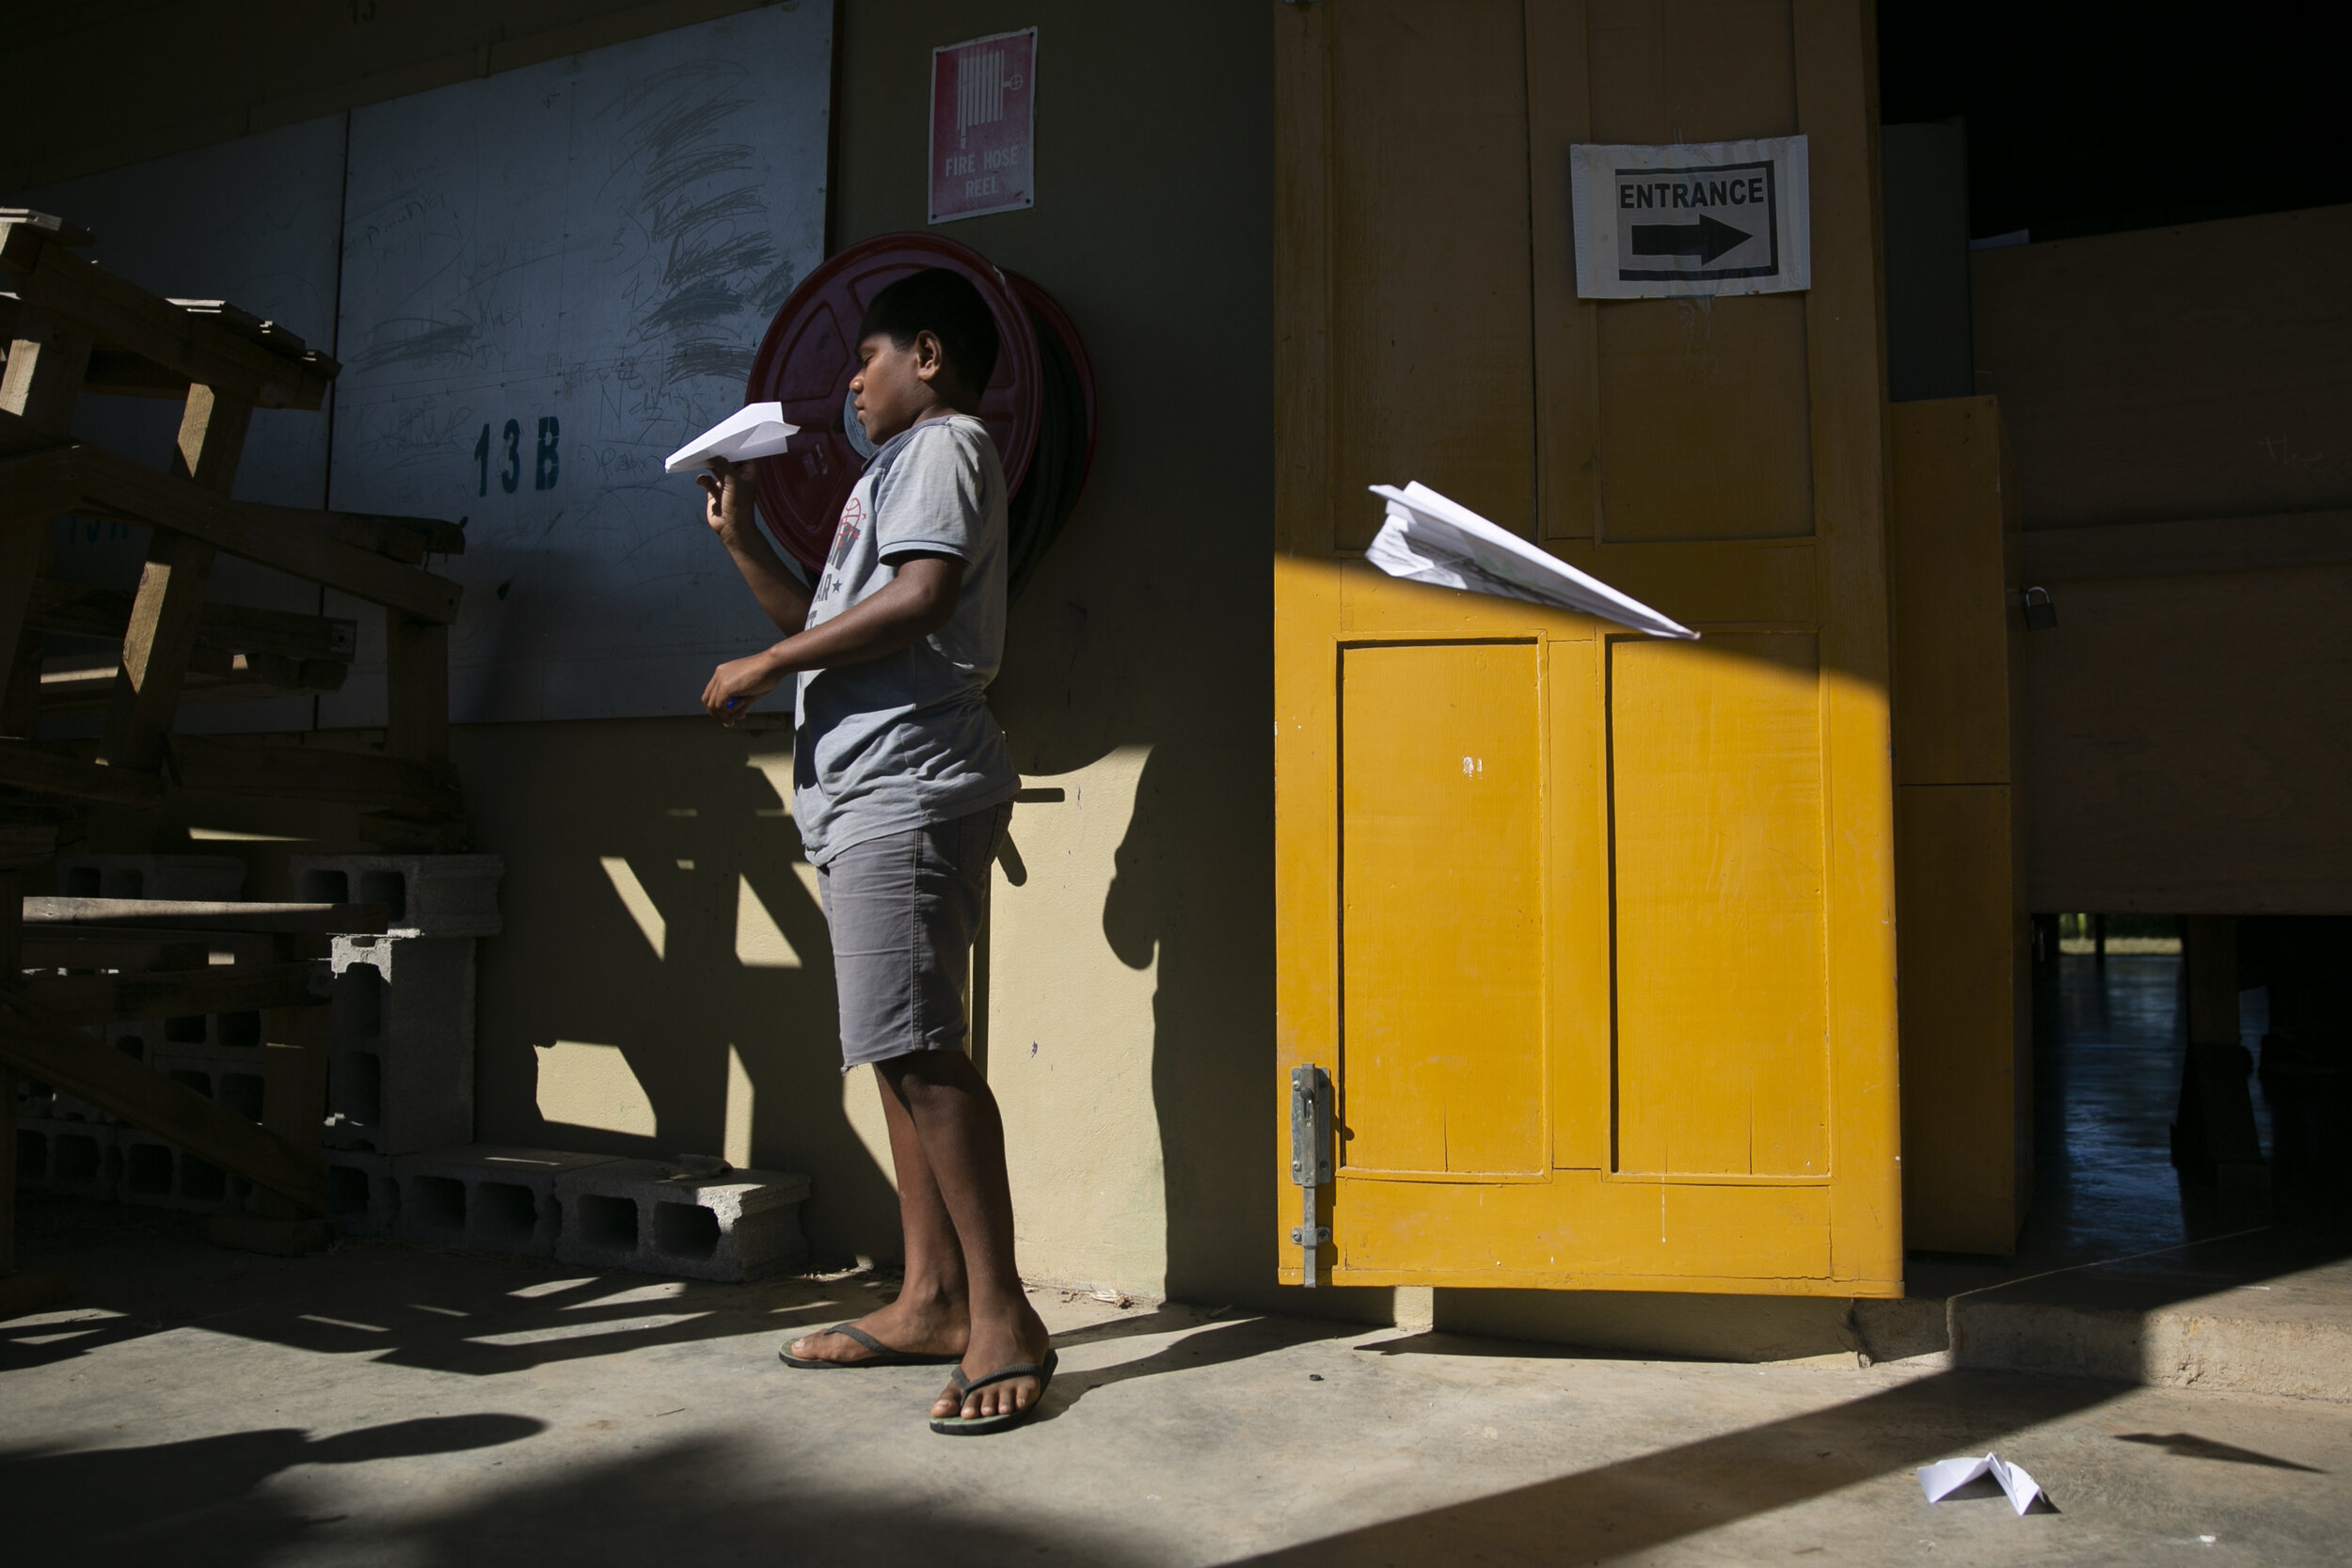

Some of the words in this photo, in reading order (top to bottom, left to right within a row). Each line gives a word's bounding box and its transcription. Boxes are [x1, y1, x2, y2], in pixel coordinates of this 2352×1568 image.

[945, 153, 977, 177] FIRE
[983, 145, 1019, 170] HOSE
[965, 176, 999, 198] REEL
[1619, 177, 1765, 209] ENTRANCE
